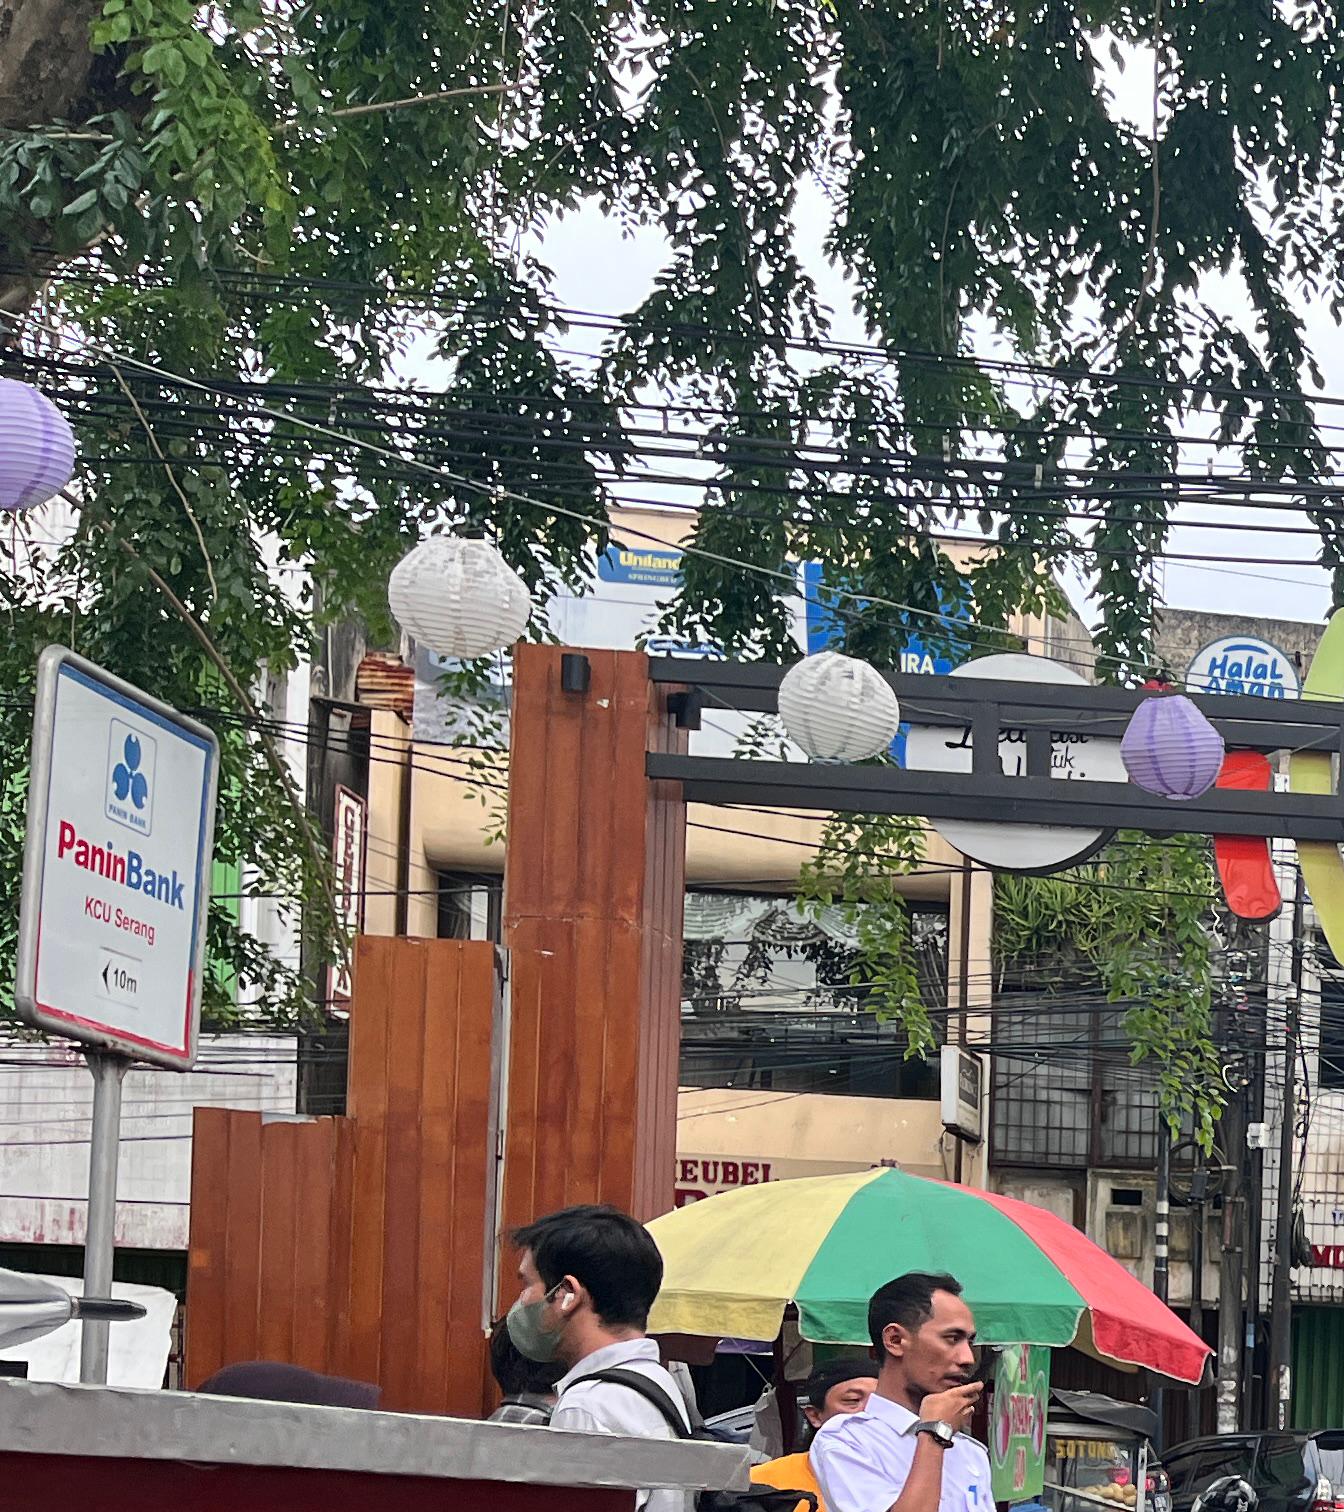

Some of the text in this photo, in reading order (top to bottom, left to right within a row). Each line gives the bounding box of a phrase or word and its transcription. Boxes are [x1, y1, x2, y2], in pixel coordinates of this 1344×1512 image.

[57, 820, 185, 910] PaninBank
[85, 895, 155, 946] KCU Serang
[113, 967, 137, 994] 10m
[675, 1158, 780, 1185] EUBEL
